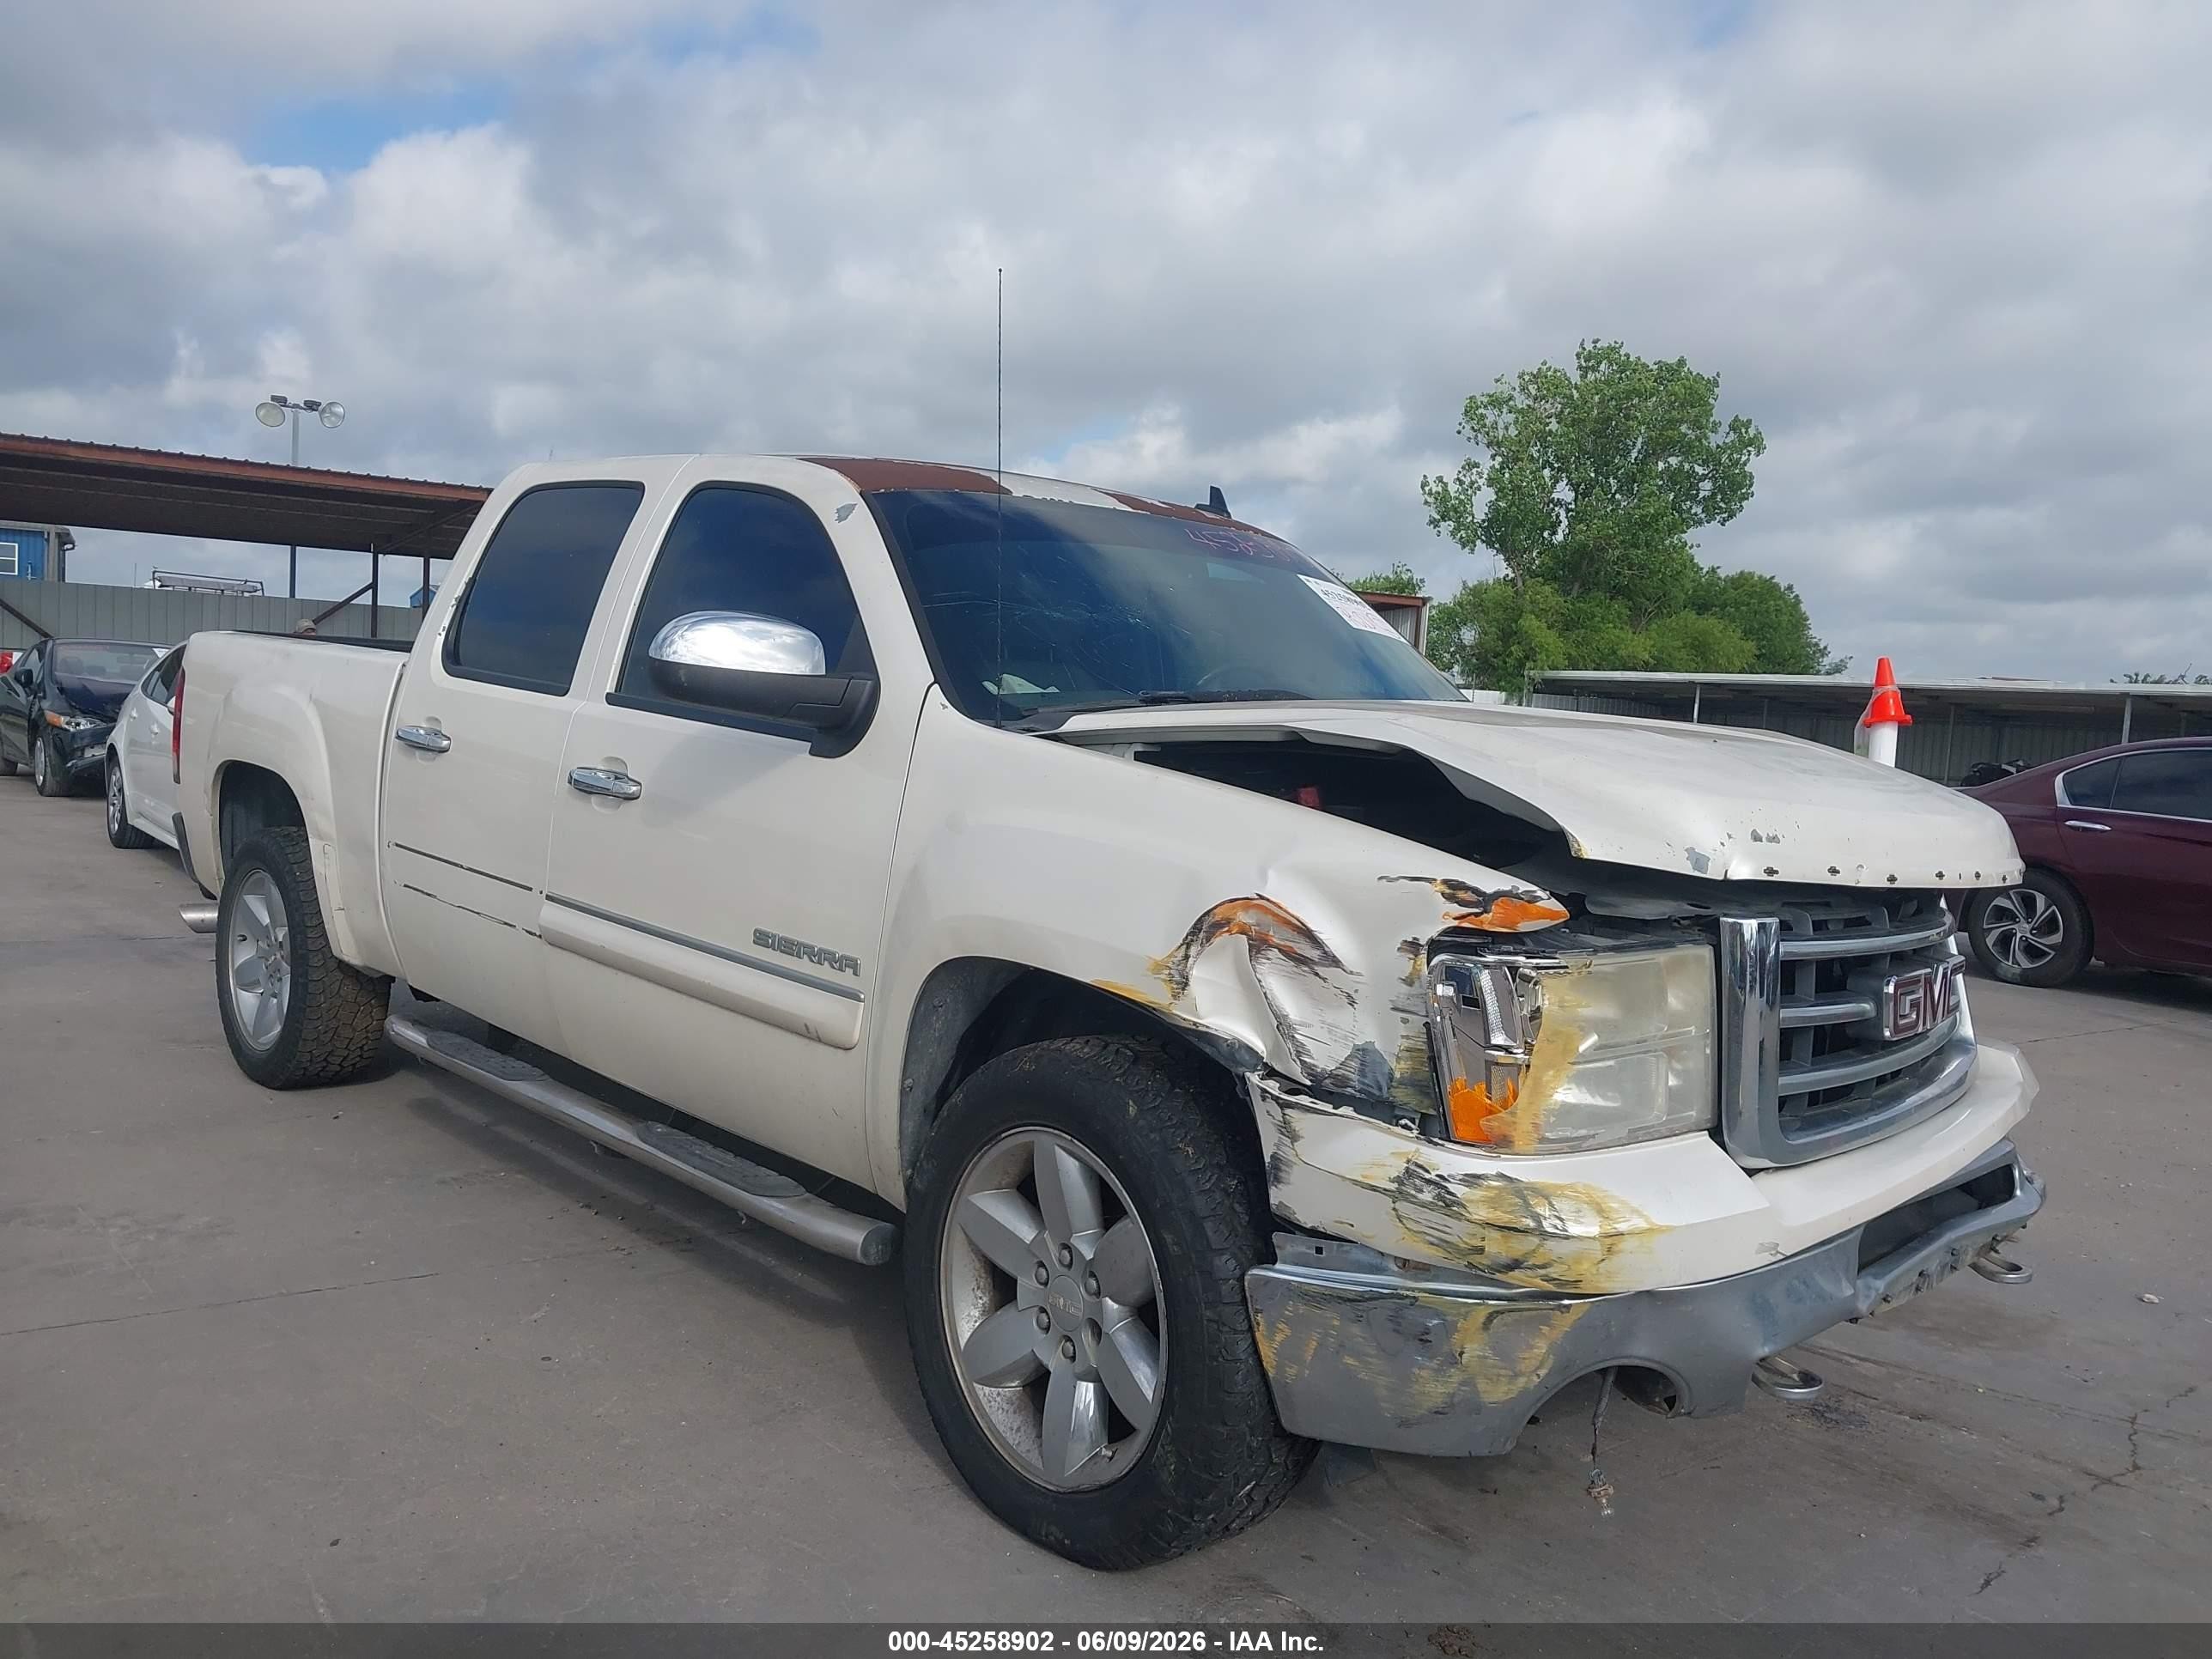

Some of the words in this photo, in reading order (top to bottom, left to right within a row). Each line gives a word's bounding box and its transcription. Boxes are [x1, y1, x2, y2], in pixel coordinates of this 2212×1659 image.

[752, 927, 861, 977] SIERRA
[1883, 955, 1966, 1041] GMC
[1048, 1291, 1083, 1318] GMC
